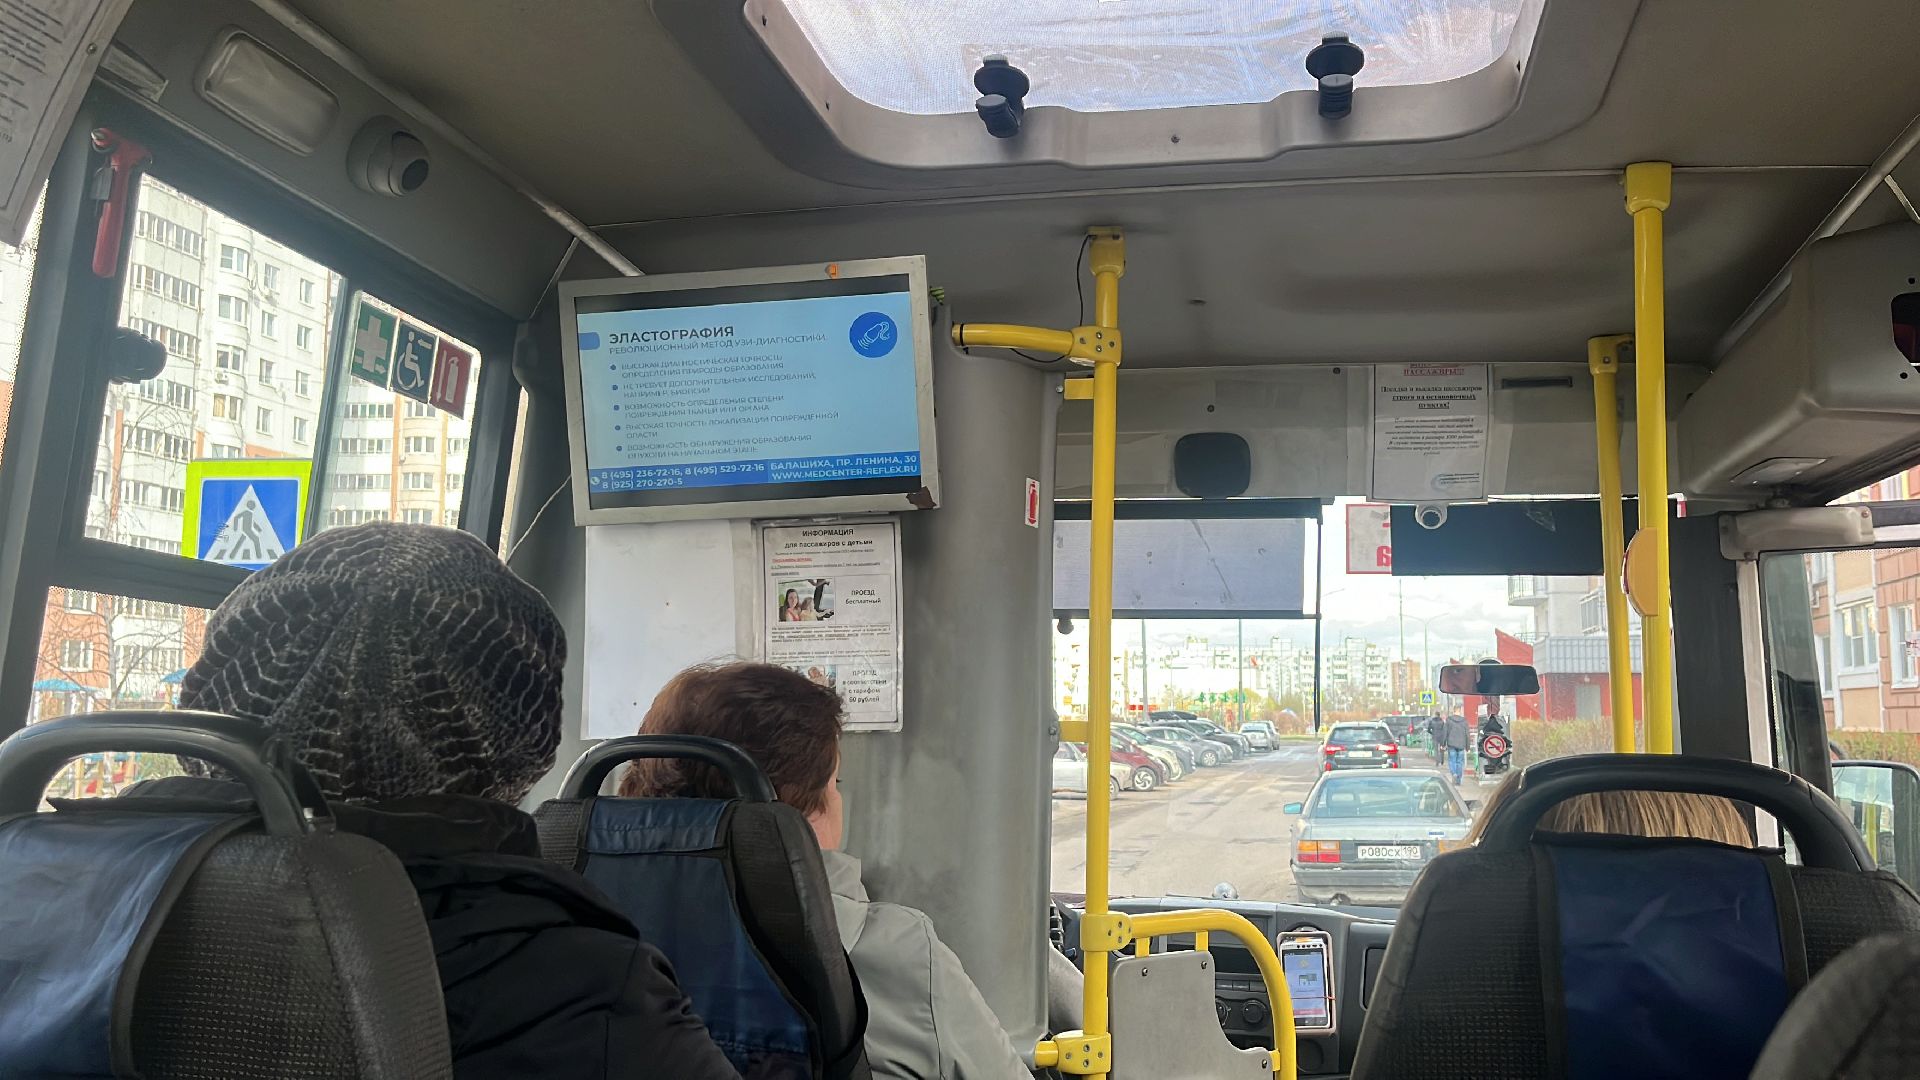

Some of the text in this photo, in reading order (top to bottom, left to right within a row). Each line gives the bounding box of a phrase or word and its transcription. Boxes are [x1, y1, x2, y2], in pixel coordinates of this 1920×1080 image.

[609, 326, 734, 344] ЭЛАСТОГРАФИЯ
[609, 333, 827, 355] РЕВОЛЮЦИОННЫЙ МЕТОД УЗИ-ДИАГНОСТИКИ
[770, 455, 917, 471] БАЛАШИХА, ПР. ЛЕНИНА, 30
[610, 470, 634, 480] (495)
[636, 468, 683, 478] 236-72-16,
[694, 466, 718, 476] (495)
[720, 463, 765, 473] 529-72-16
[772, 465, 918, 481] WWW.MEDCENTER-REFLEX.RU
[602, 478, 683, 490] 8 (925) 270-270-5
[802, 528, 854, 537] ИНФОРМАЦИЯ
[784, 541, 798, 549] для
[799, 540, 840, 549] пассажиров
[847, 539, 873, 547] детьми
[850, 589, 876, 597] ПРОЕЗД
